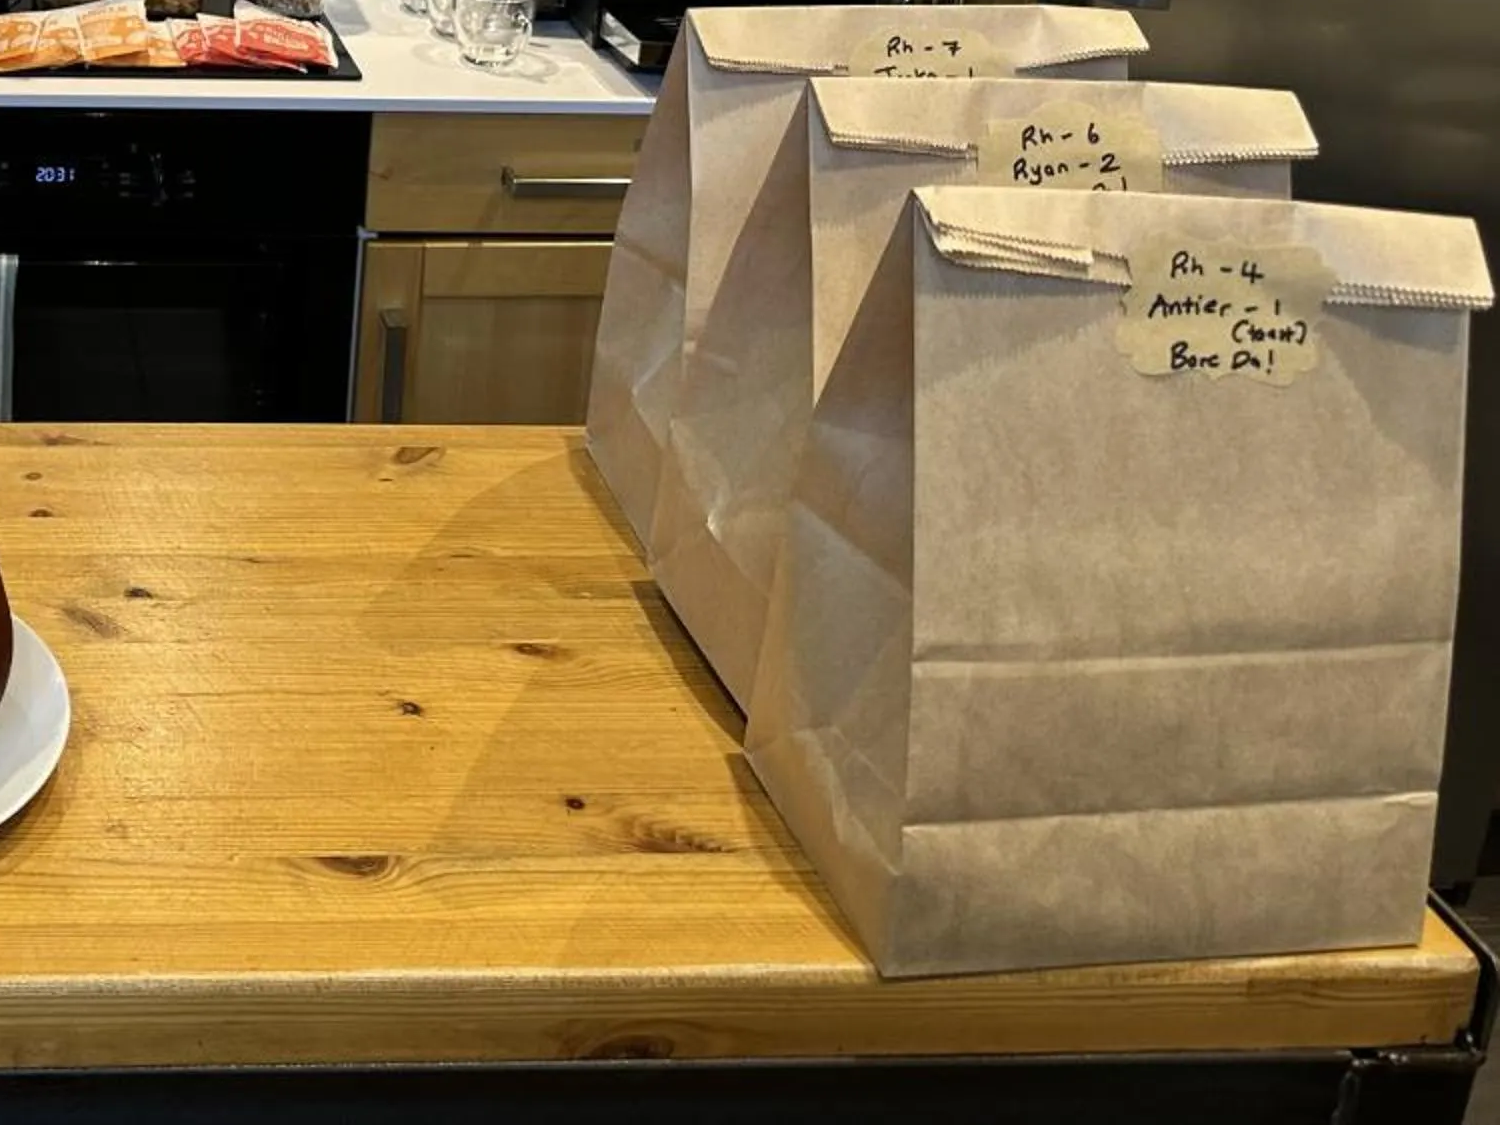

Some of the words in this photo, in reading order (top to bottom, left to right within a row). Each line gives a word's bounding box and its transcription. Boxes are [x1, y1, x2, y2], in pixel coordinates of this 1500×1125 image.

[1087, 122, 1101, 145] 6
[1012, 157, 1069, 185] Ryan
[1100, 152, 1121, 173] 2
[1147, 293, 1232, 319] Antier
